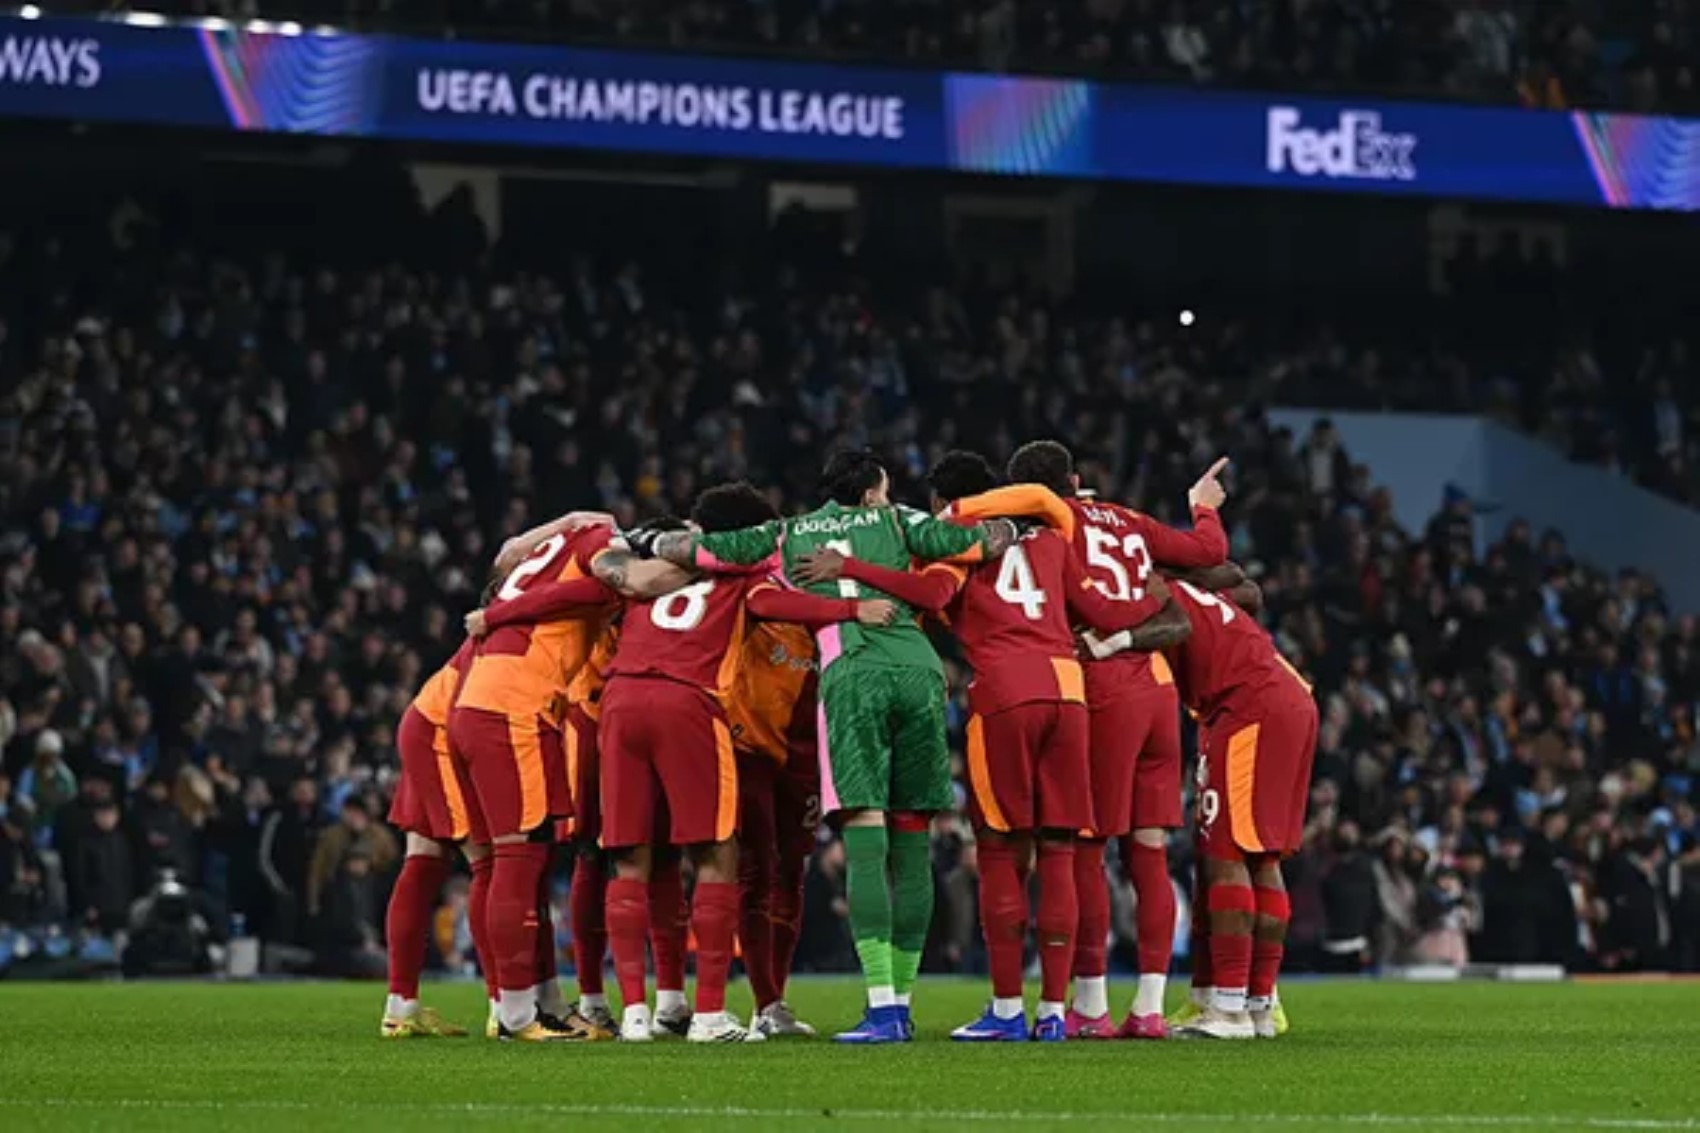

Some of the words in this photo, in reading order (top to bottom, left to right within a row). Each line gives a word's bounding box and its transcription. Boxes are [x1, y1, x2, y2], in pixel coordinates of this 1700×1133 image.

[418, 68, 516, 116] UEFA
[523, 74, 751, 131] CHAMPIONS
[757, 89, 904, 139] LEAGUE
[1267, 106, 1416, 180] FedEx
[497, 533, 566, 601] 2
[995, 545, 1048, 620] 4
